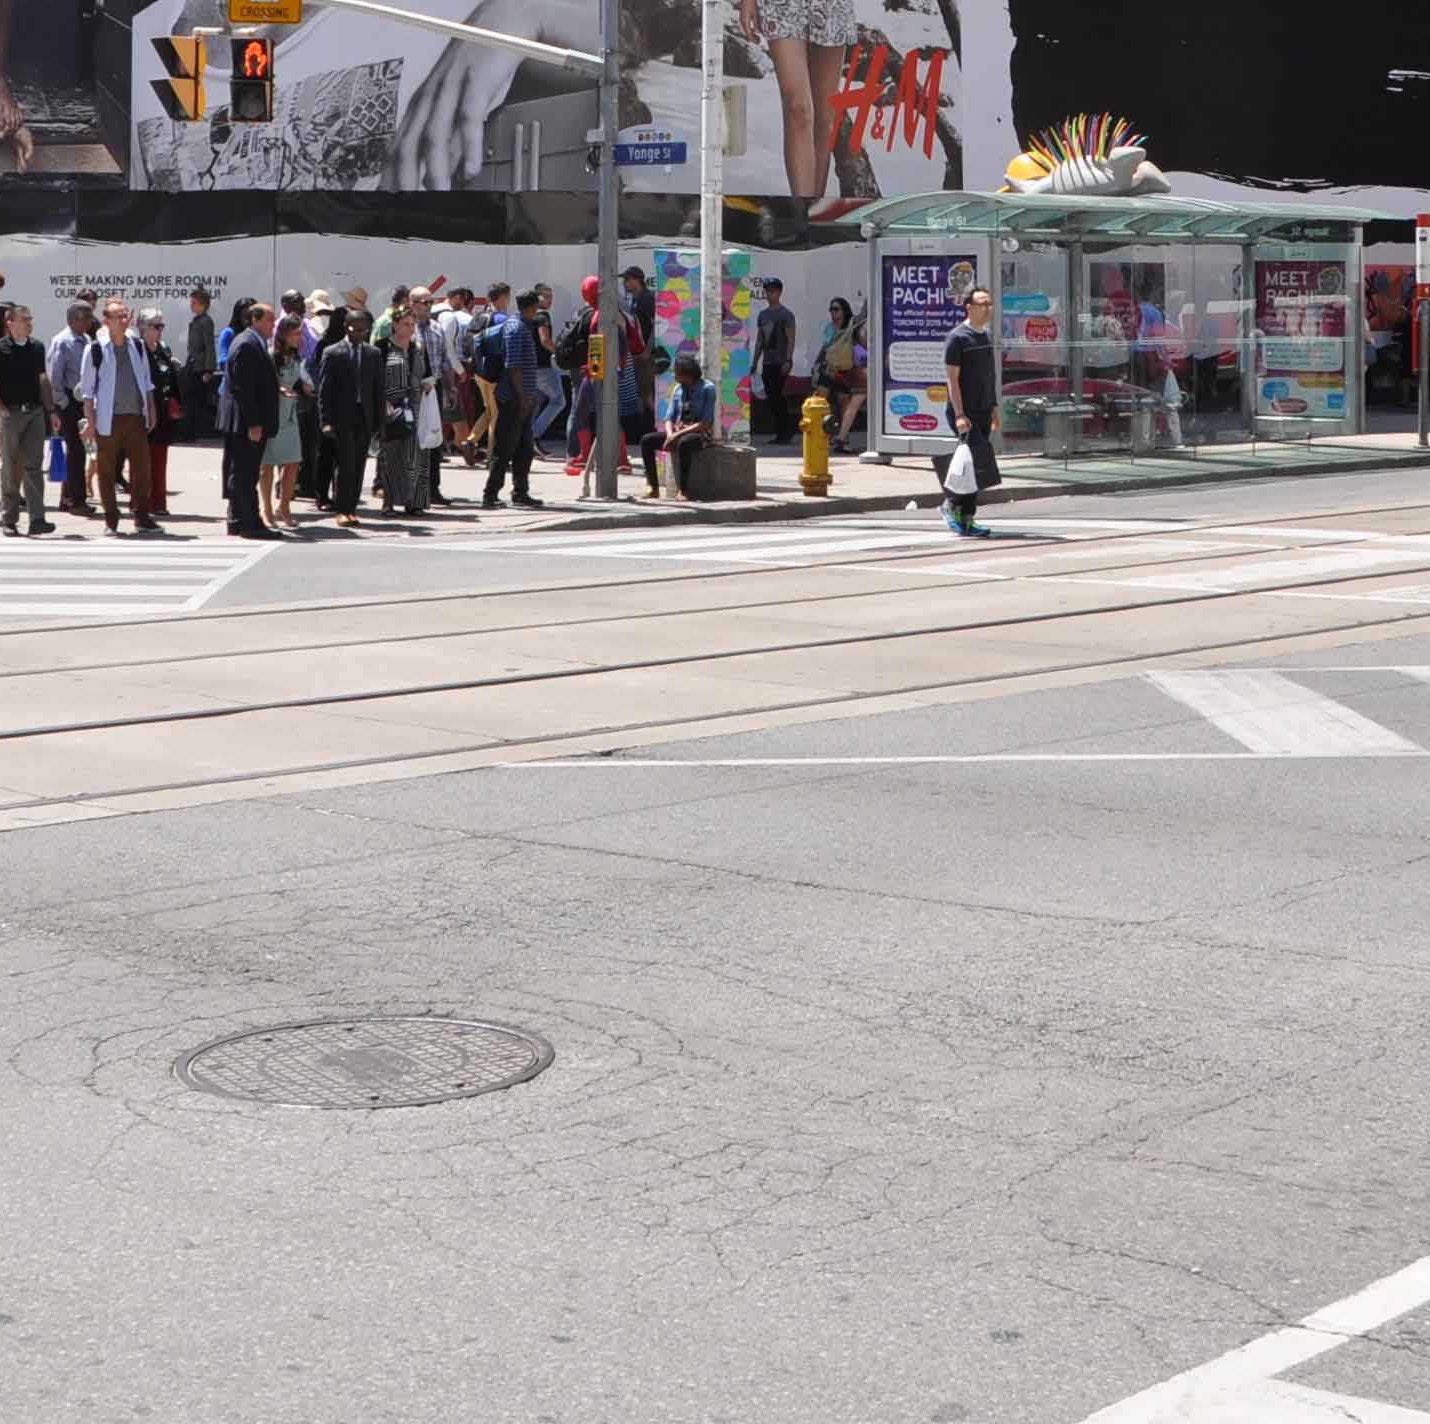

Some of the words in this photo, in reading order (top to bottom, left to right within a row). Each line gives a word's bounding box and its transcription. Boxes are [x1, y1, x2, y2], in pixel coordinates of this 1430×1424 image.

[240, 5, 290, 19] CROSSING
[827, 39, 945, 161] H&M
[627, 146, 661, 164] Yonge
[662, 147, 671, 160] St
[50, 275, 83, 286] WE'RE
[86, 275, 134, 286] MAKING
[137, 275, 172, 286] MORE
[175, 275, 212, 286] ROOM
[214, 275, 228, 286] IN
[892, 265, 940, 284] MEET
[1265, 270, 1308, 286] MEET
[54, 287, 77, 299] OUR
[96, 287, 130, 301] OSET,
[131, 287, 164, 299] JUST
[165, 287, 188, 299] FOR
[892, 287, 945, 305] PACHI
[892, 319, 925, 327] TORONTO
